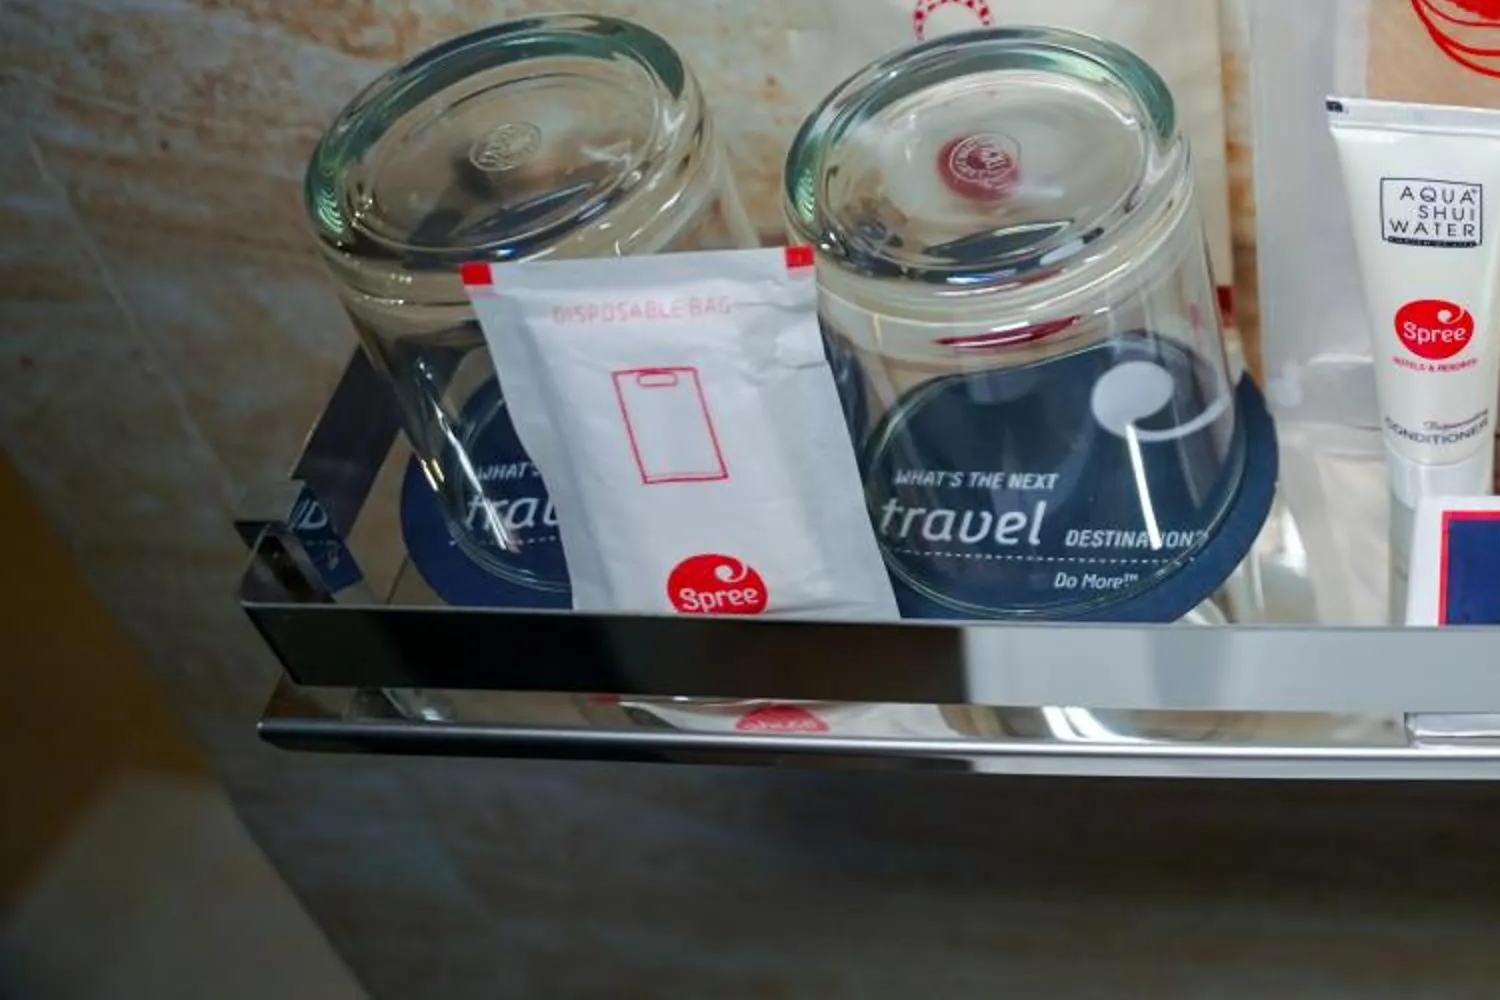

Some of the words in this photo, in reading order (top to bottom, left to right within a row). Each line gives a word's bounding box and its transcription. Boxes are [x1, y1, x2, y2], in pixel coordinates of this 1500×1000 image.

[1399, 185, 1475, 205] AQUA
[1417, 204, 1475, 221] SHUI
[1389, 218, 1476, 237] WATER
[552, 300, 684, 325] DISPOSABLE
[689, 295, 731, 318] BAG
[1403, 321, 1467, 345] Spree
[894, 468, 965, 488] WHAT'S
[969, 470, 1005, 489] THE
[1008, 472, 1060, 490] NEXT
[879, 497, 1047, 546] travel
[1055, 572, 1078, 588] Do
[679, 587, 760, 613] Spree
